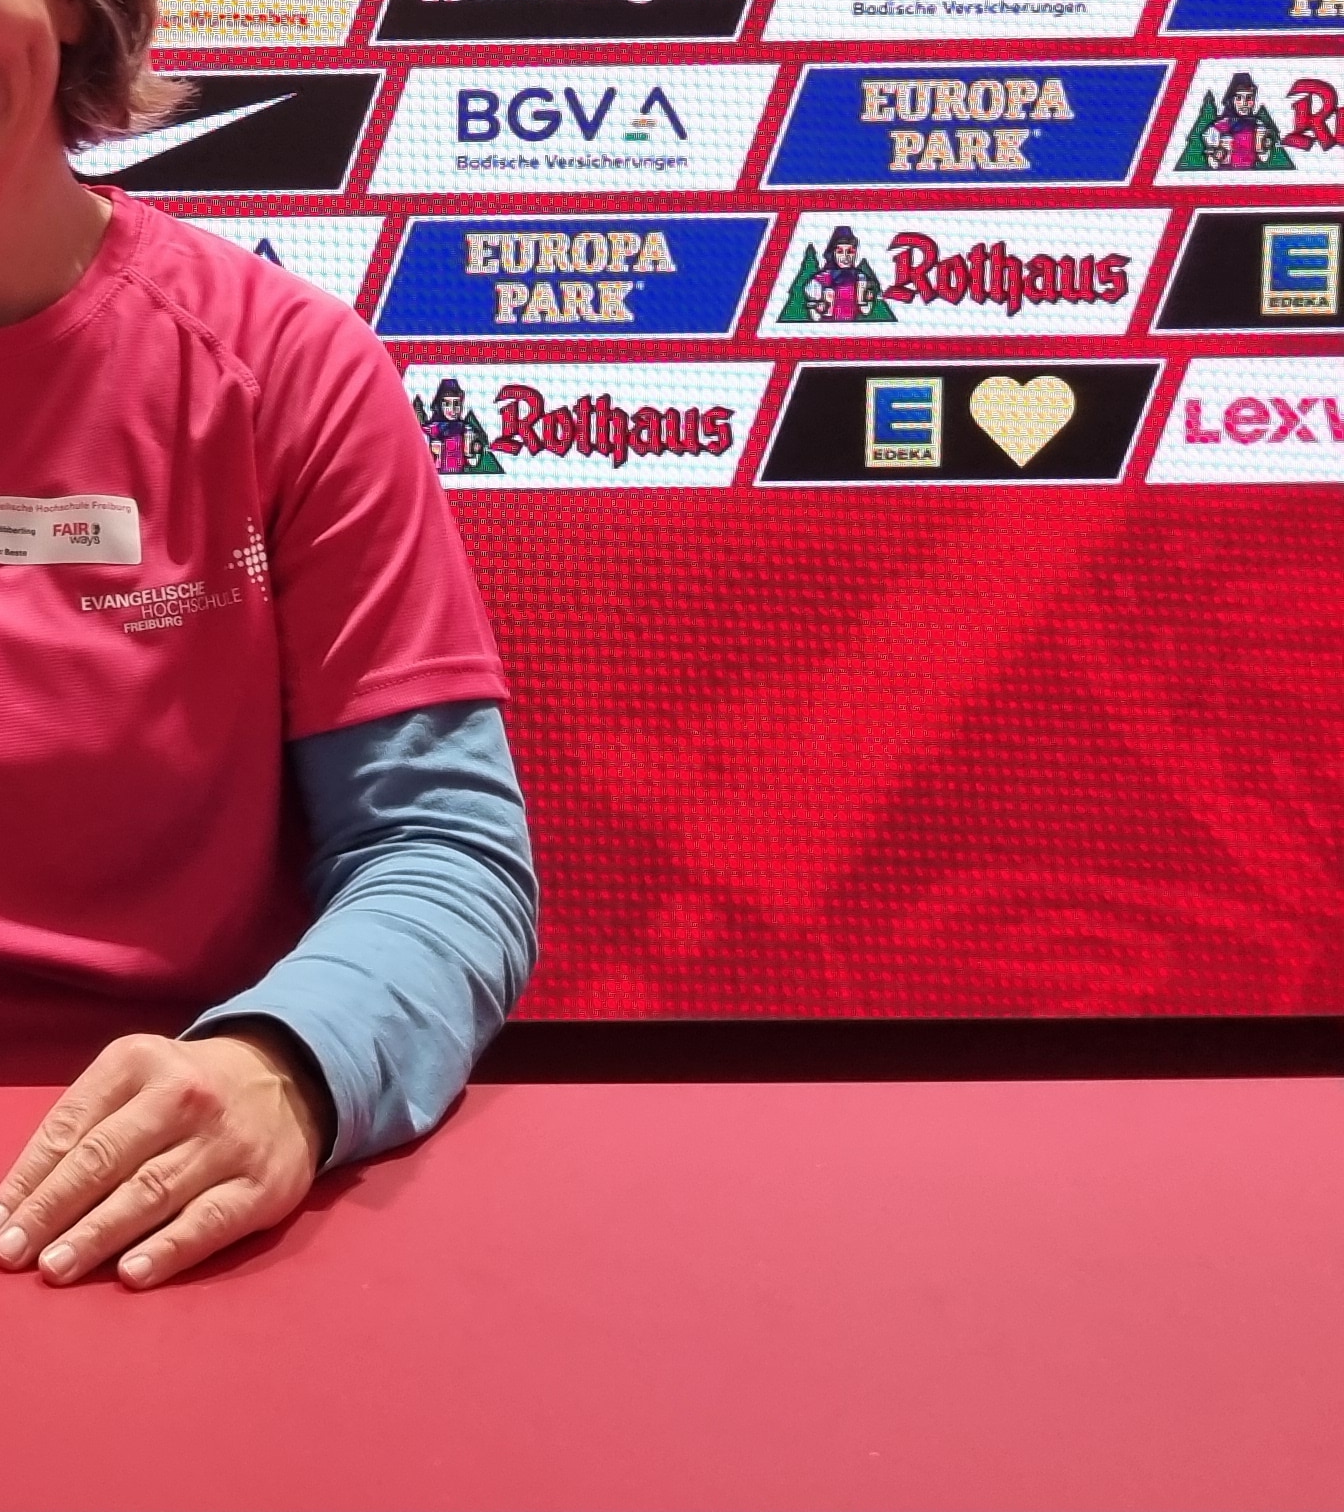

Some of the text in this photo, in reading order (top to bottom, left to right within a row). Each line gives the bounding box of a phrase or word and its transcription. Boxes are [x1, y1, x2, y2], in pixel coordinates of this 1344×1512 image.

[852, 0, 1088, 18] Badische Versicherungen
[860, 78, 1075, 123] EUROPA
[456, 154, 690, 173] Badische Versicherungen
[464, 231, 678, 275] EUROPA
[884, 232, 1132, 316] Rothaus
[488, 383, 734, 468] Rothaus
[52, 522, 90, 537] FAIR
[81, 581, 206, 612] EVANGELISCHE
[140, 587, 243, 620] HOCHSCHULE
[123, 615, 183, 634] FREIBURG
